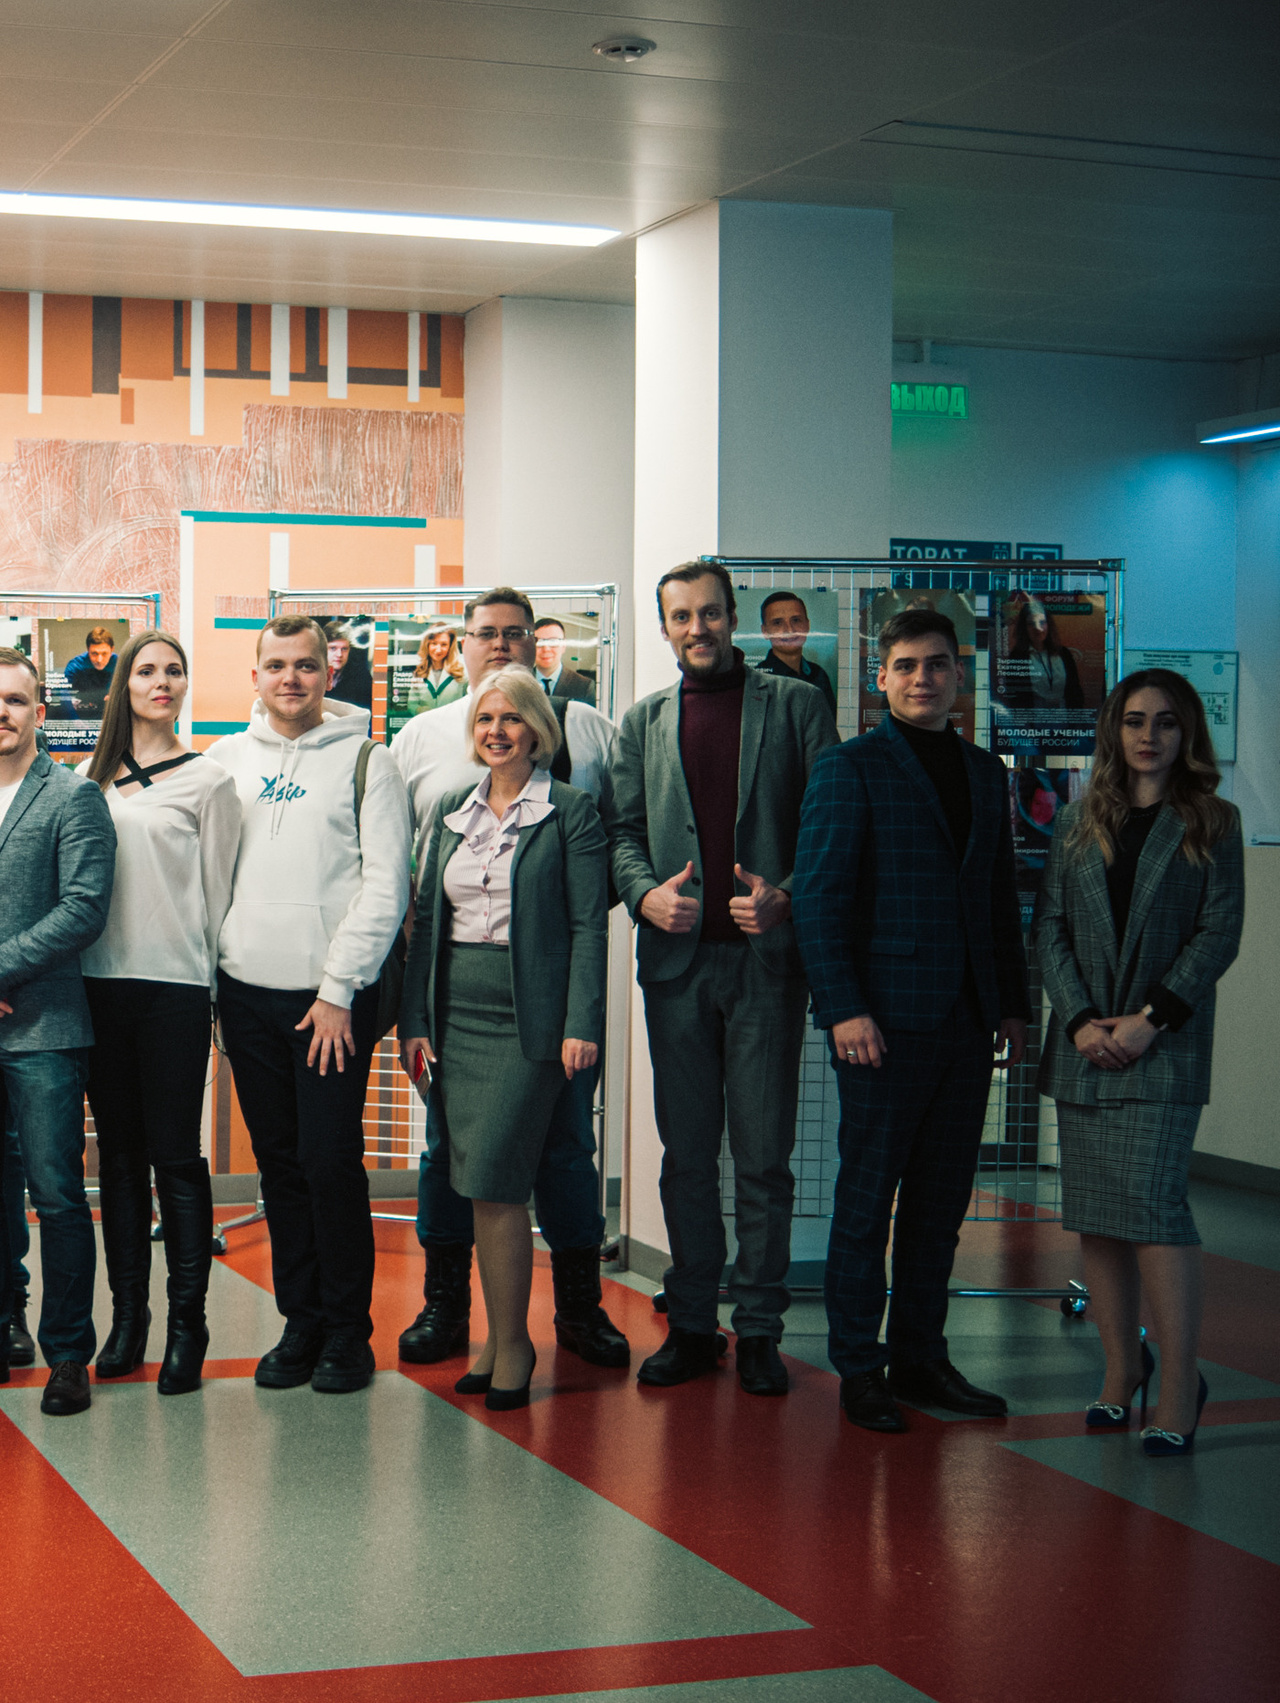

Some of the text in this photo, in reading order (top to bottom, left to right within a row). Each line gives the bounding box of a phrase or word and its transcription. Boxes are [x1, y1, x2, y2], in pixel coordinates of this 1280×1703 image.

[891, 384, 966, 416] ВЫХОД
[892, 546, 967, 560] ТОРАТ
[997, 728, 1095, 737] МОЛОДЫЕ УЧЕНЫЕ
[47, 738, 77, 746] УДУЩЕЕ
[997, 738, 1080, 747] БУДУЩЕЕ РОССИИ
